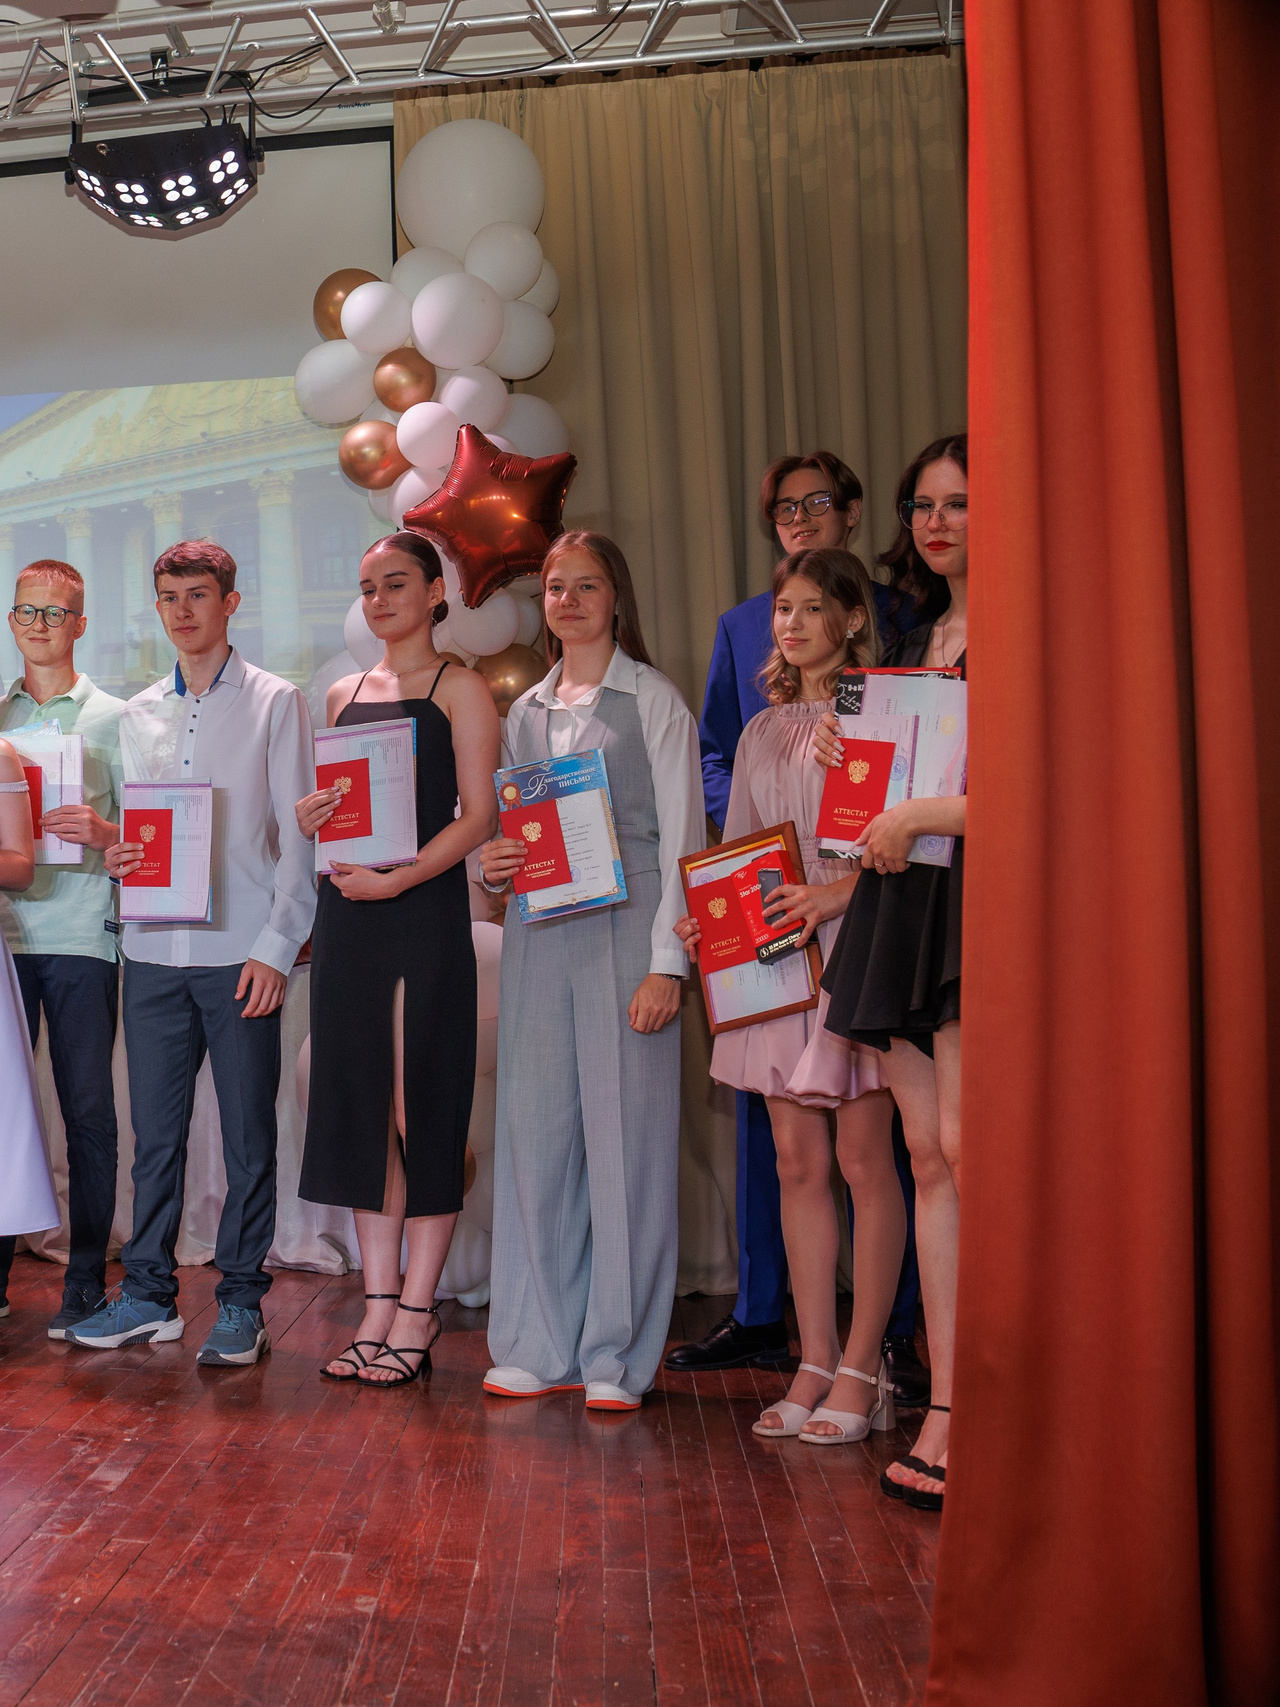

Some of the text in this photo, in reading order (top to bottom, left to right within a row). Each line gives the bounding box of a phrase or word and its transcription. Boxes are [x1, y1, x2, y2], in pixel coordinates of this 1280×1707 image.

[558, 775, 591, 788] ПИСЬМО
[833, 807, 869, 817] АТТЕСТАТ
[523, 859, 555, 871] АТТЕСТАТ
[710, 936, 741, 949] АТТЕСТАТ
